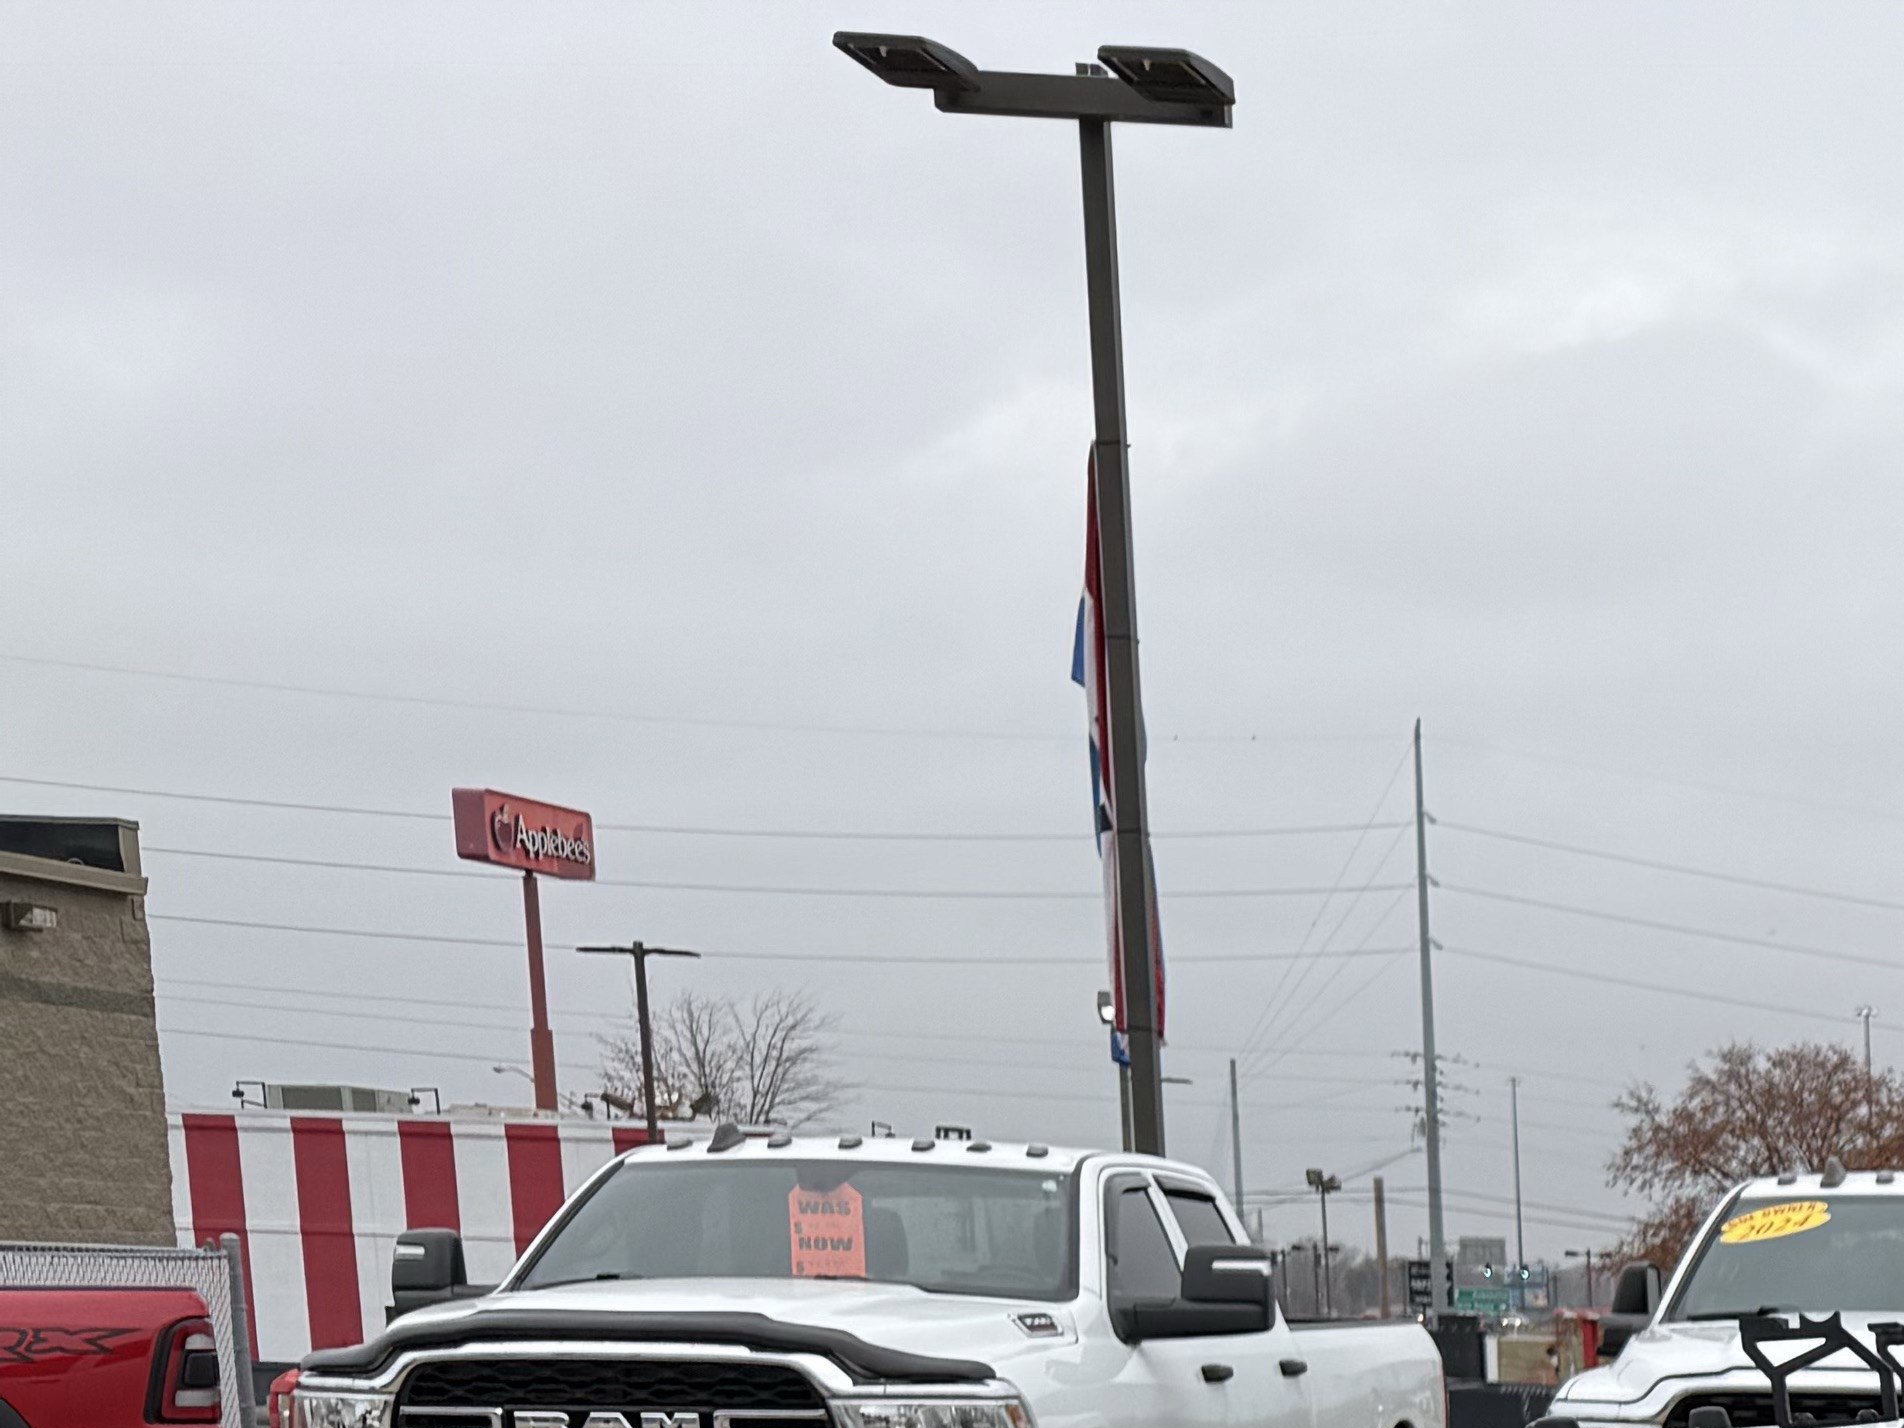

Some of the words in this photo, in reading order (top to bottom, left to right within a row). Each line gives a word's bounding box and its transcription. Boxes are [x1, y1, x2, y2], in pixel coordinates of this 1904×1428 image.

[799, 1200, 852, 1216] WAS
[1738, 1211, 1815, 1240] 2024
[799, 1236, 854, 1252] NOW
